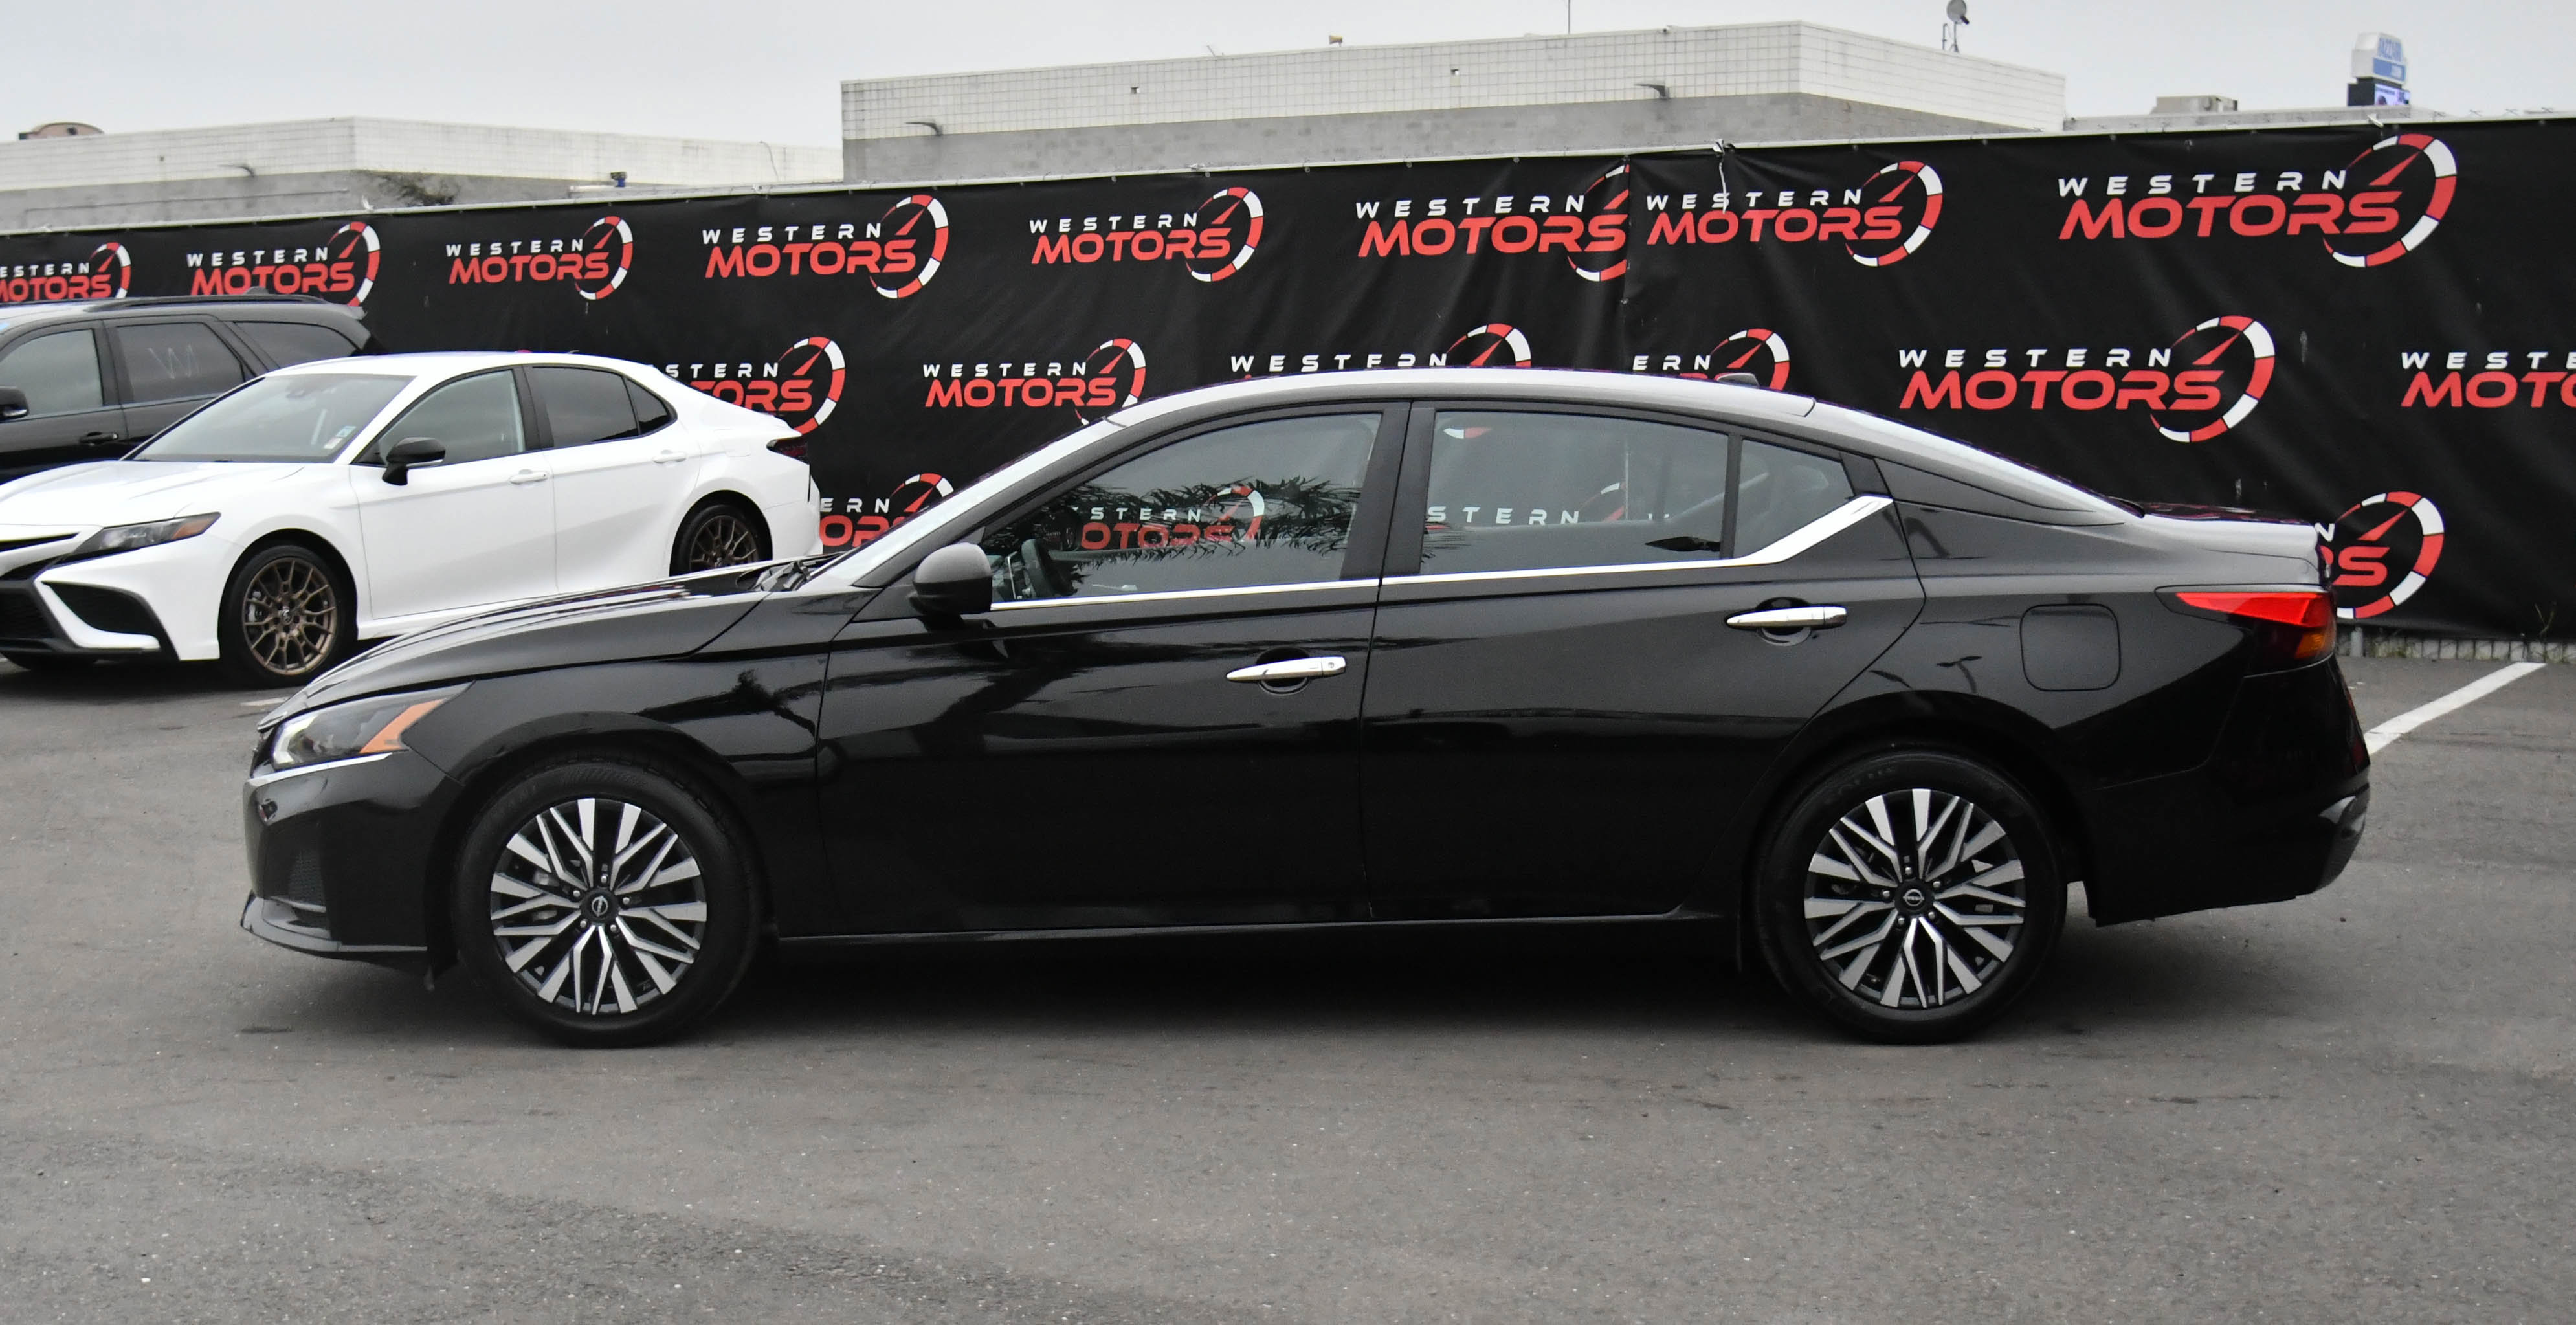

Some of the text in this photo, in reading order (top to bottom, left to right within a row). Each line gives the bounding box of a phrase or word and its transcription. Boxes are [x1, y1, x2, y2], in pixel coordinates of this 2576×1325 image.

[2058, 170, 2346, 197] WESTERN
[1356, 195, 1584, 219] WESTERN
[1647, 189, 1861, 210] WESTERN
[1029, 212, 1197, 234] WESTERN
[1647, 206, 1903, 245] MOTORS
[2059, 191, 2402, 240] MOTORS
[702, 223, 881, 245] WESTERN
[1358, 214, 1628, 258] MOTORS
[187, 247, 328, 267] WESTERN
[446, 239, 583, 257] WESTERN
[1032, 228, 1231, 265] MOTORS
[449, 252, 610, 284] MOTORS
[705, 239, 916, 278] MOTORS
[0, 263, 89, 278] ESTERN
[191, 262, 355, 296] MOTORS
[1899, 348, 2171, 368] WESTERN
[2401, 351, 2576, 370] WESTE
[665, 362, 779, 378] STERN
[923, 362, 1086, 378] WESTERN
[925, 377, 1116, 408] MOTORS
[1900, 370, 2224, 410] MOTORS
[2401, 371, 2576, 408] MOT
[1090, 507, 1202, 522] STERN
[1427, 506, 1579, 526] STERN
